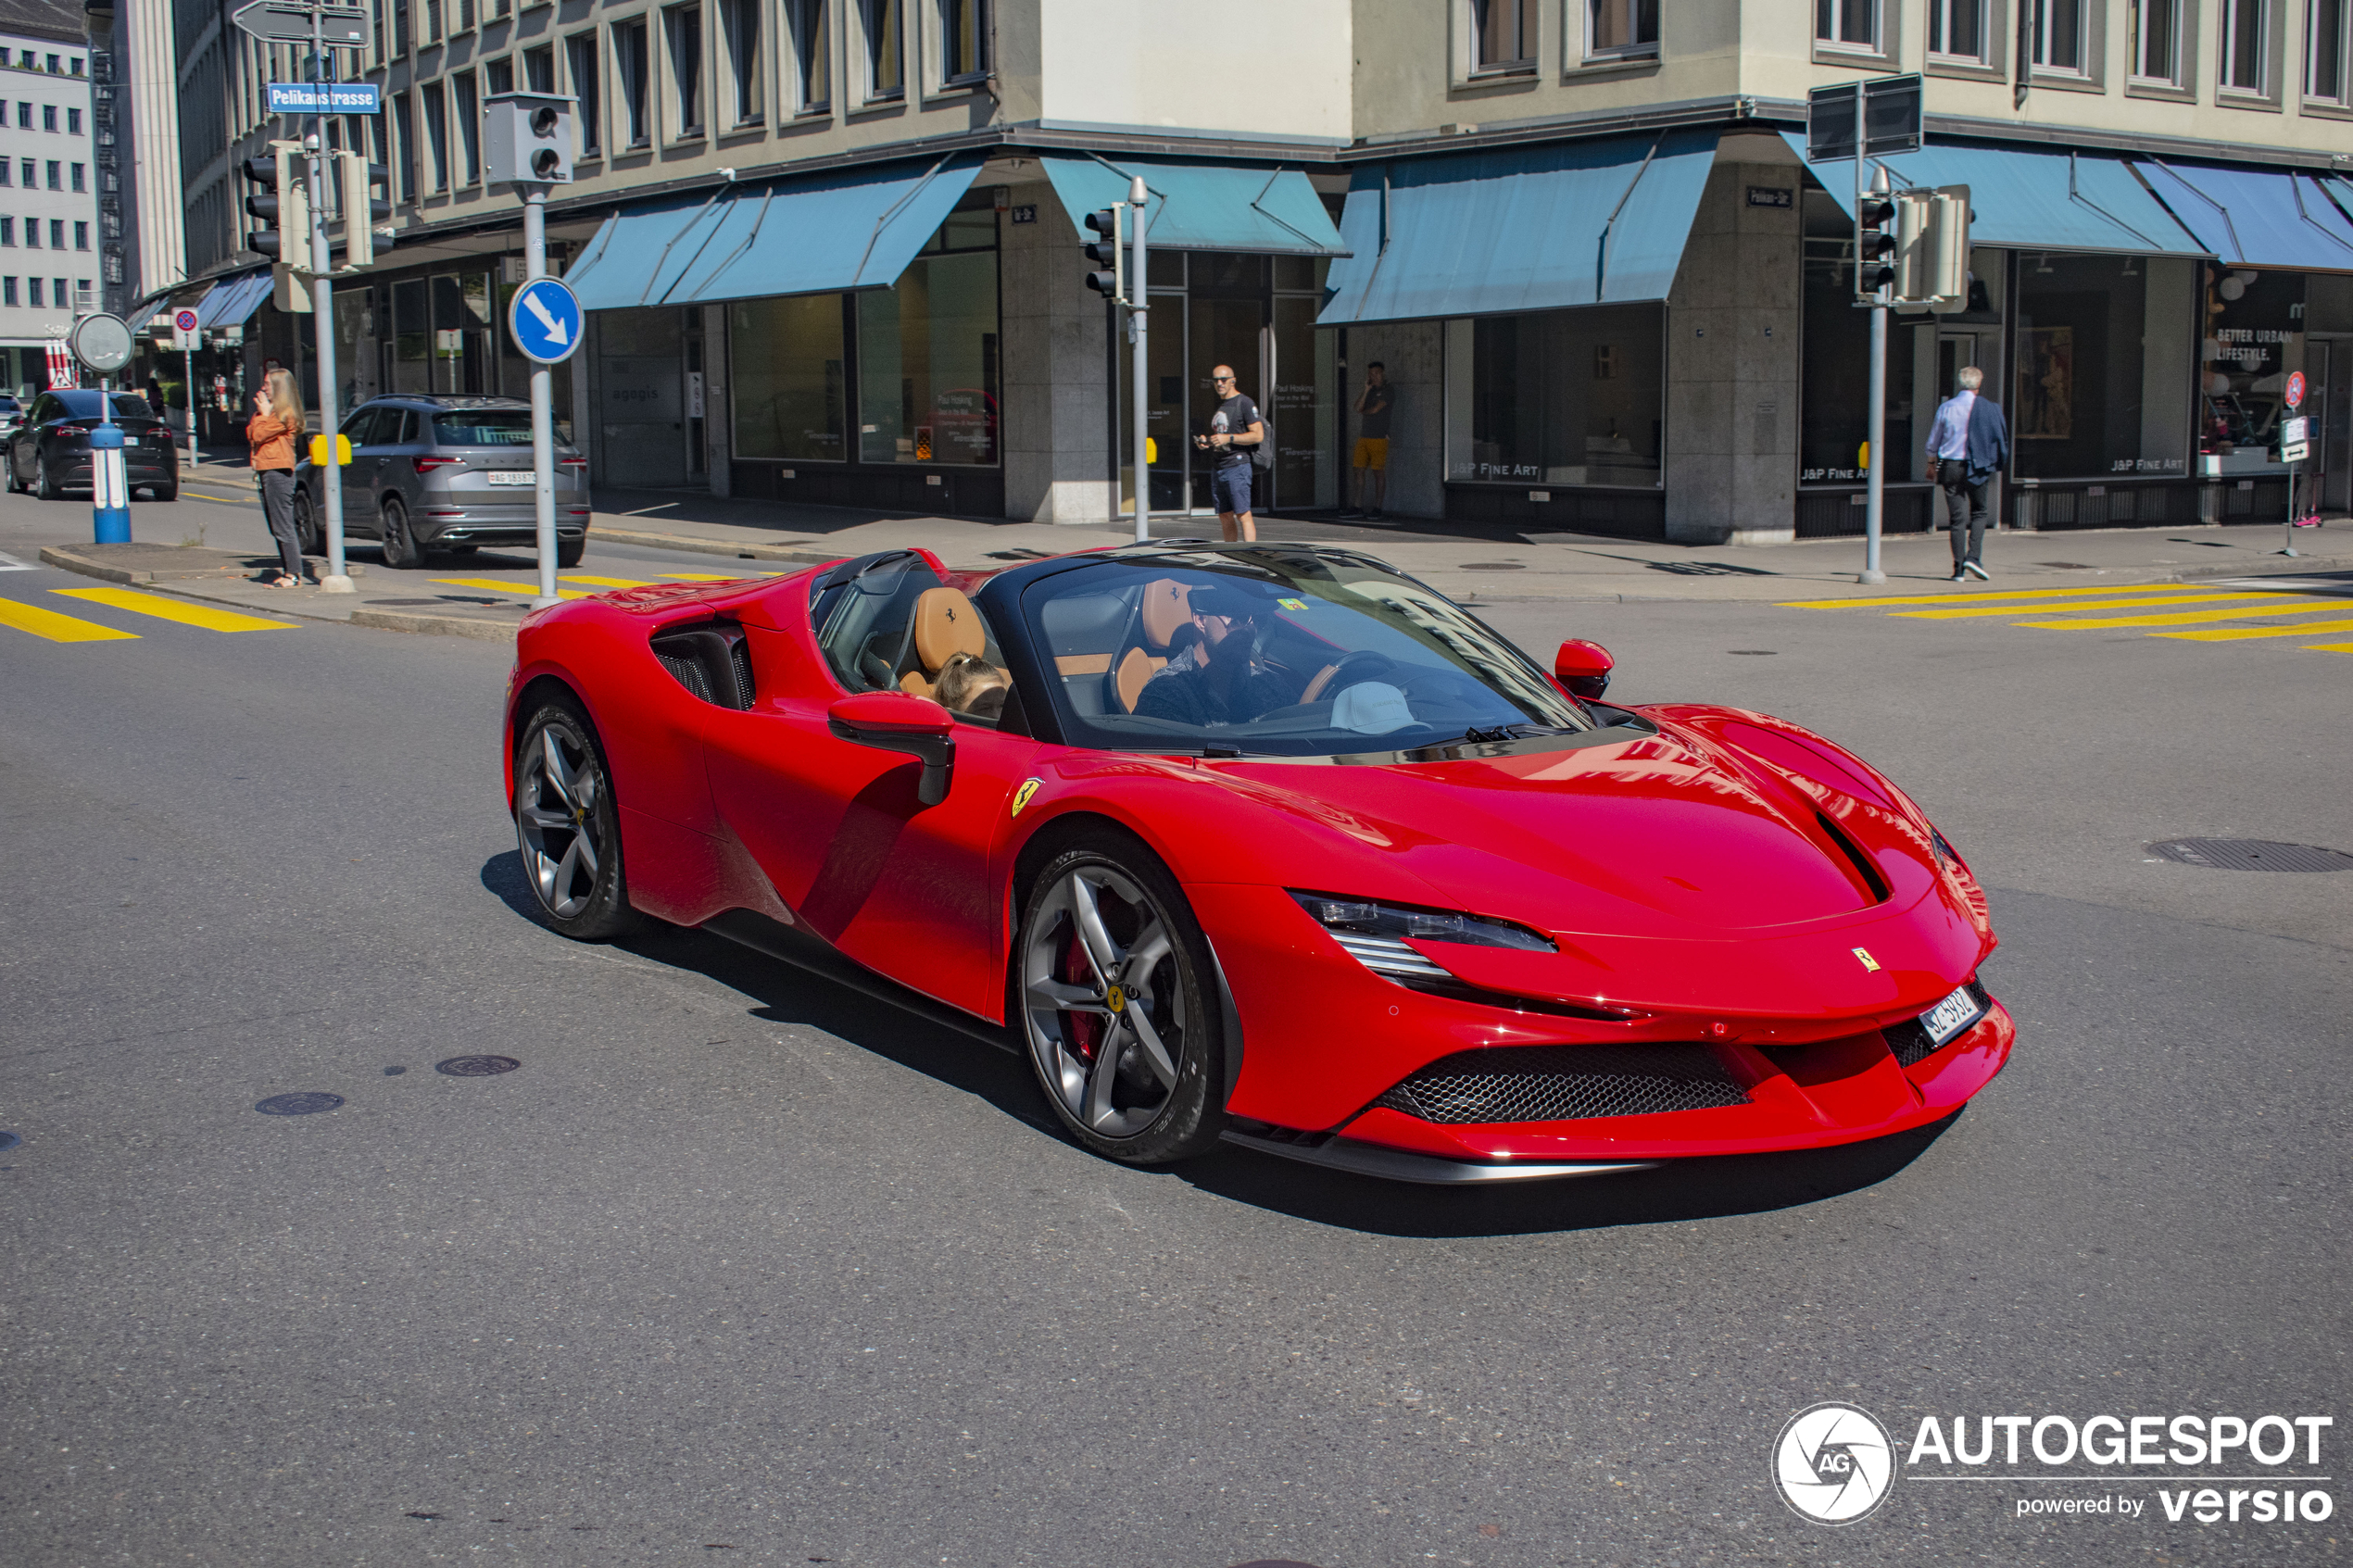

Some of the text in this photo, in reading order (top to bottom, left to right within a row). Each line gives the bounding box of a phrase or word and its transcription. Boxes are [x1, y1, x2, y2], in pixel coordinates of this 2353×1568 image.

[272, 89, 373, 106] Pelikanstrasse
[2217, 329, 2293, 344] BETTER URBAN
[2215, 347, 2271, 361] LIFESTYLE.
[1451, 462, 1539, 476] J&P FINE ART
[2111, 458, 2183, 471] J&P FINE ART
[1801, 468, 1825, 480] J&P
[1828, 468, 1855, 479] FINE
